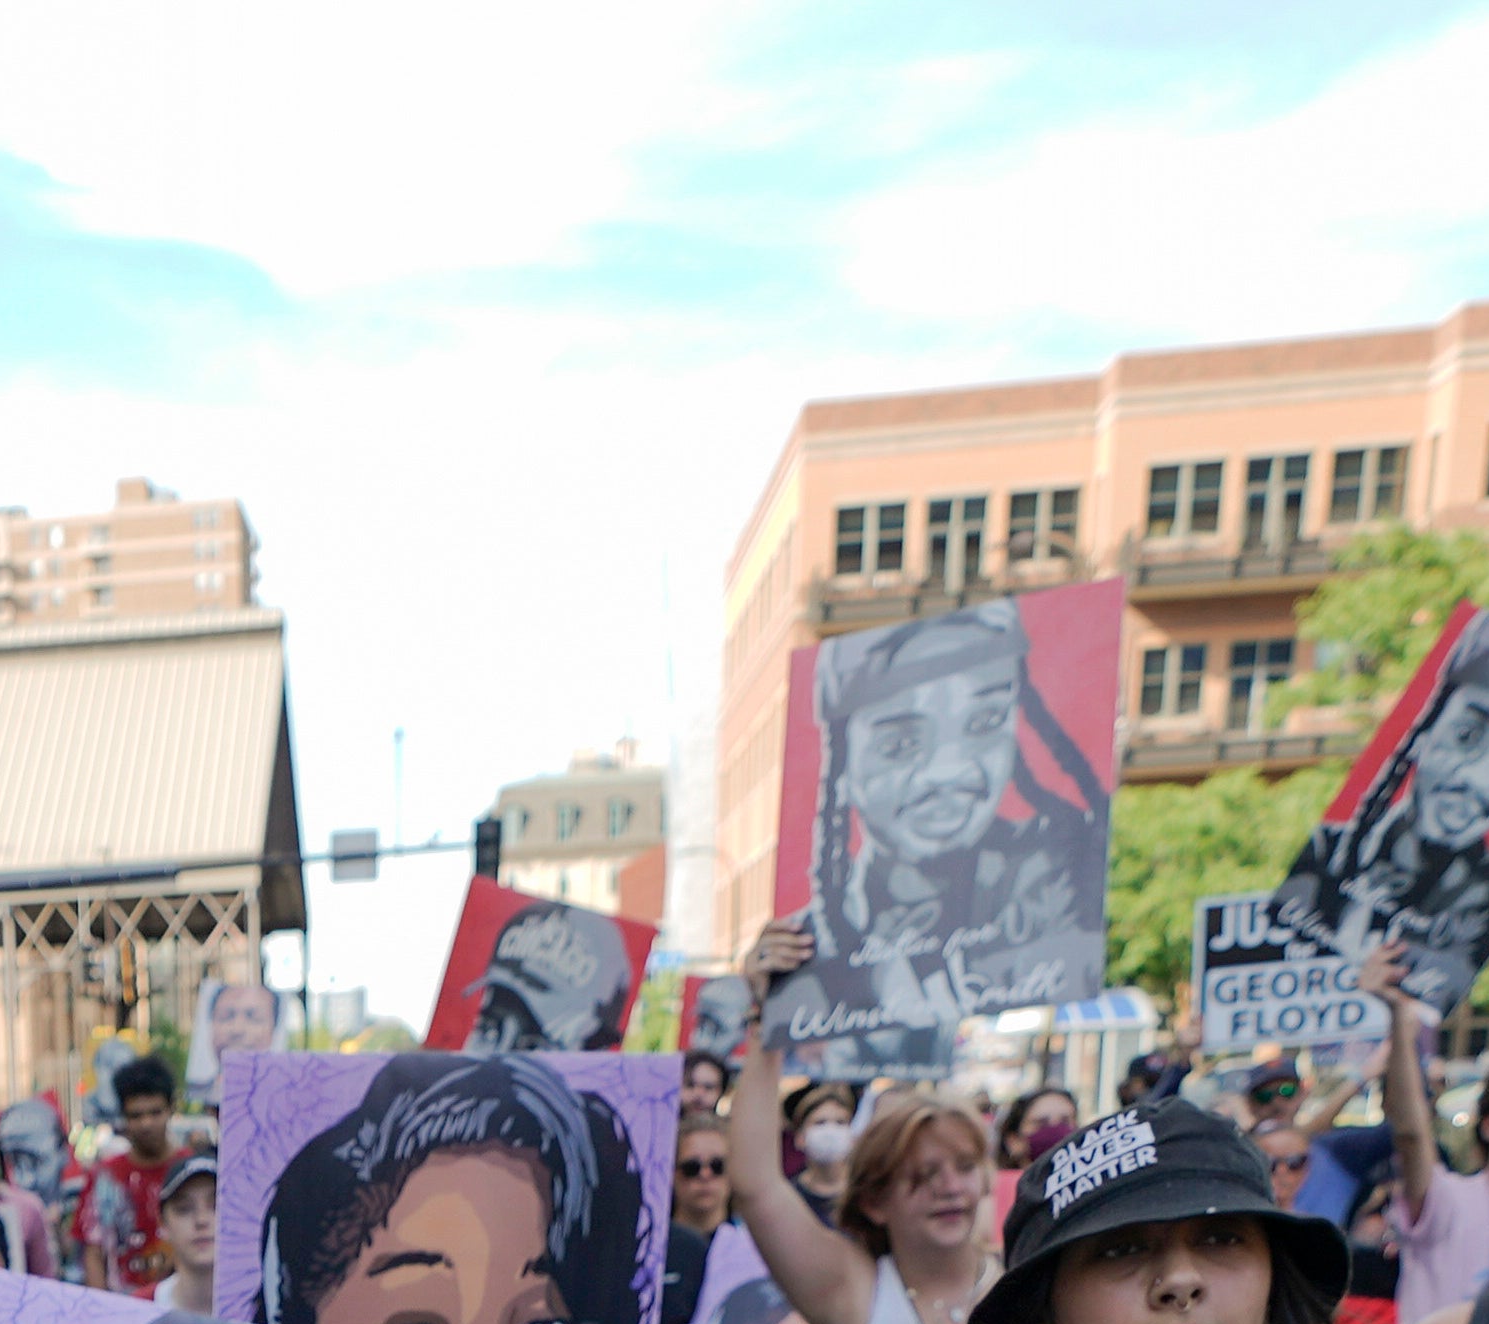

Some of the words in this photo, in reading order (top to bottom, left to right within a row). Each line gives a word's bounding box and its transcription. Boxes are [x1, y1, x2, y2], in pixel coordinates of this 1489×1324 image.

[1214, 963, 1362, 1004] GEORG
[1231, 1000, 1365, 1039] FLOYD
[1051, 1109, 1138, 1174] BLACK
[1054, 1128, 1141, 1188] LIVES
[1052, 1145, 1159, 1220] MATTER
